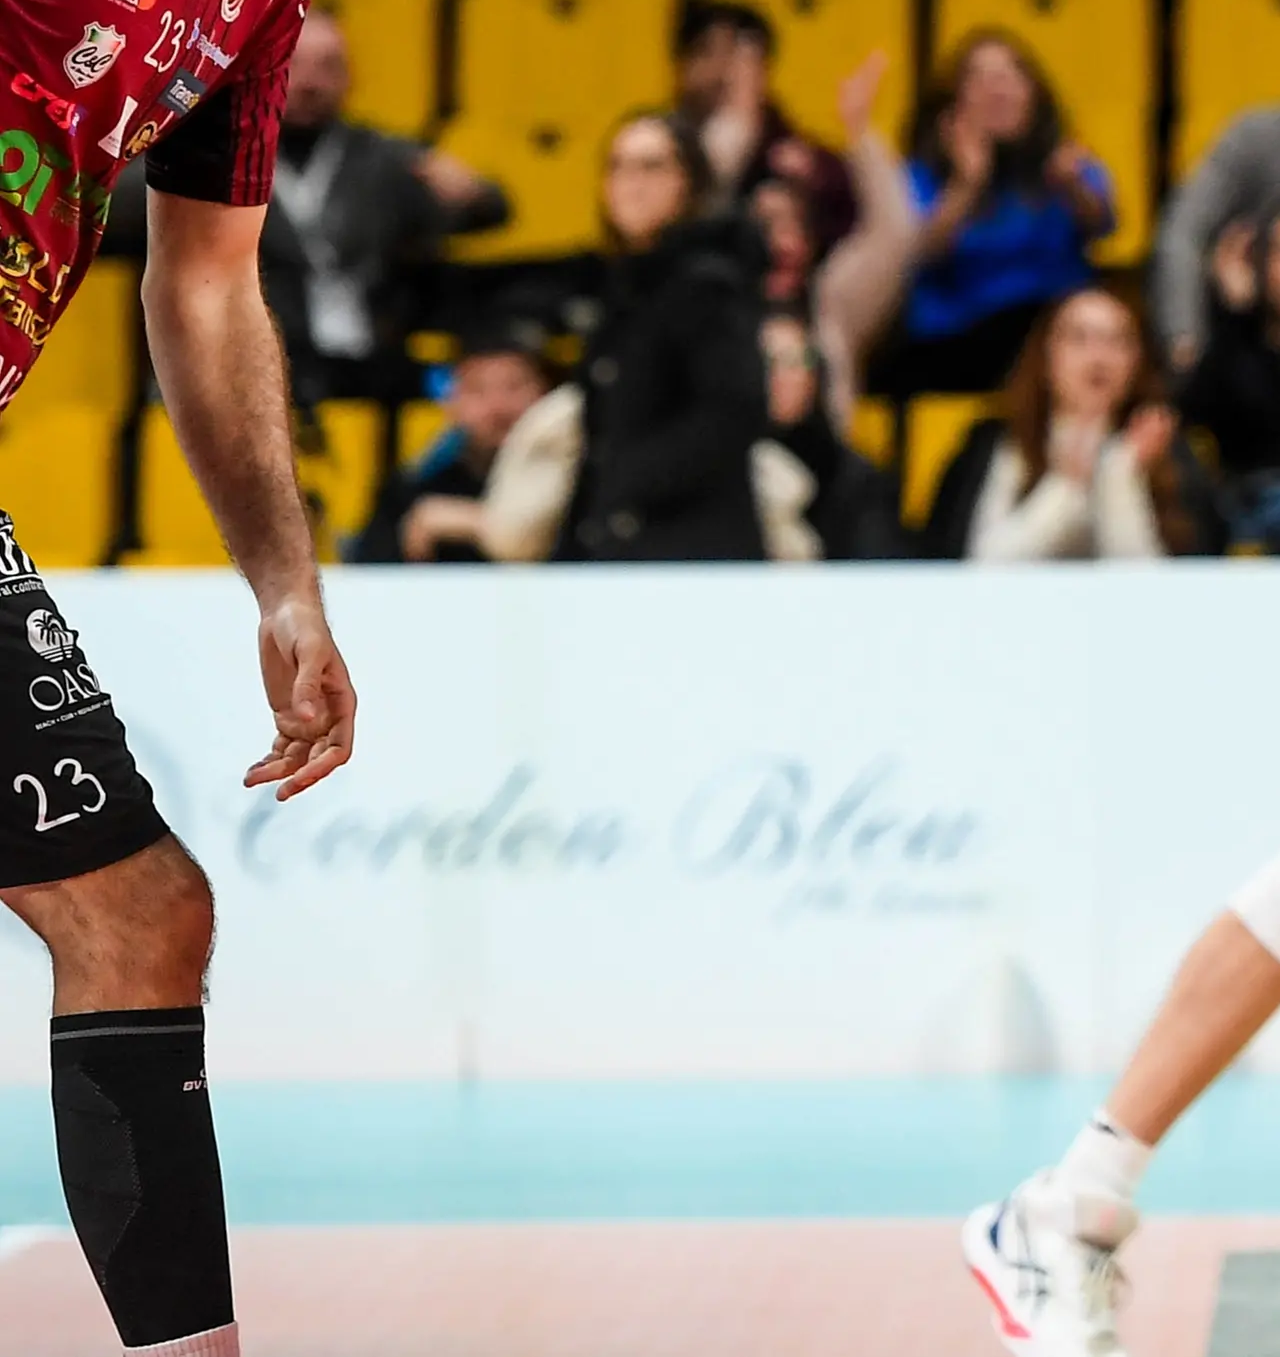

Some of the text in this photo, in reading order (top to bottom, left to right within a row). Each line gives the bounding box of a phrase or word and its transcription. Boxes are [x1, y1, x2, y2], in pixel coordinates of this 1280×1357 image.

[143, 9, 186, 74] 23
[28, 662, 101, 712] OAS
[12, 757, 107, 832] 23
